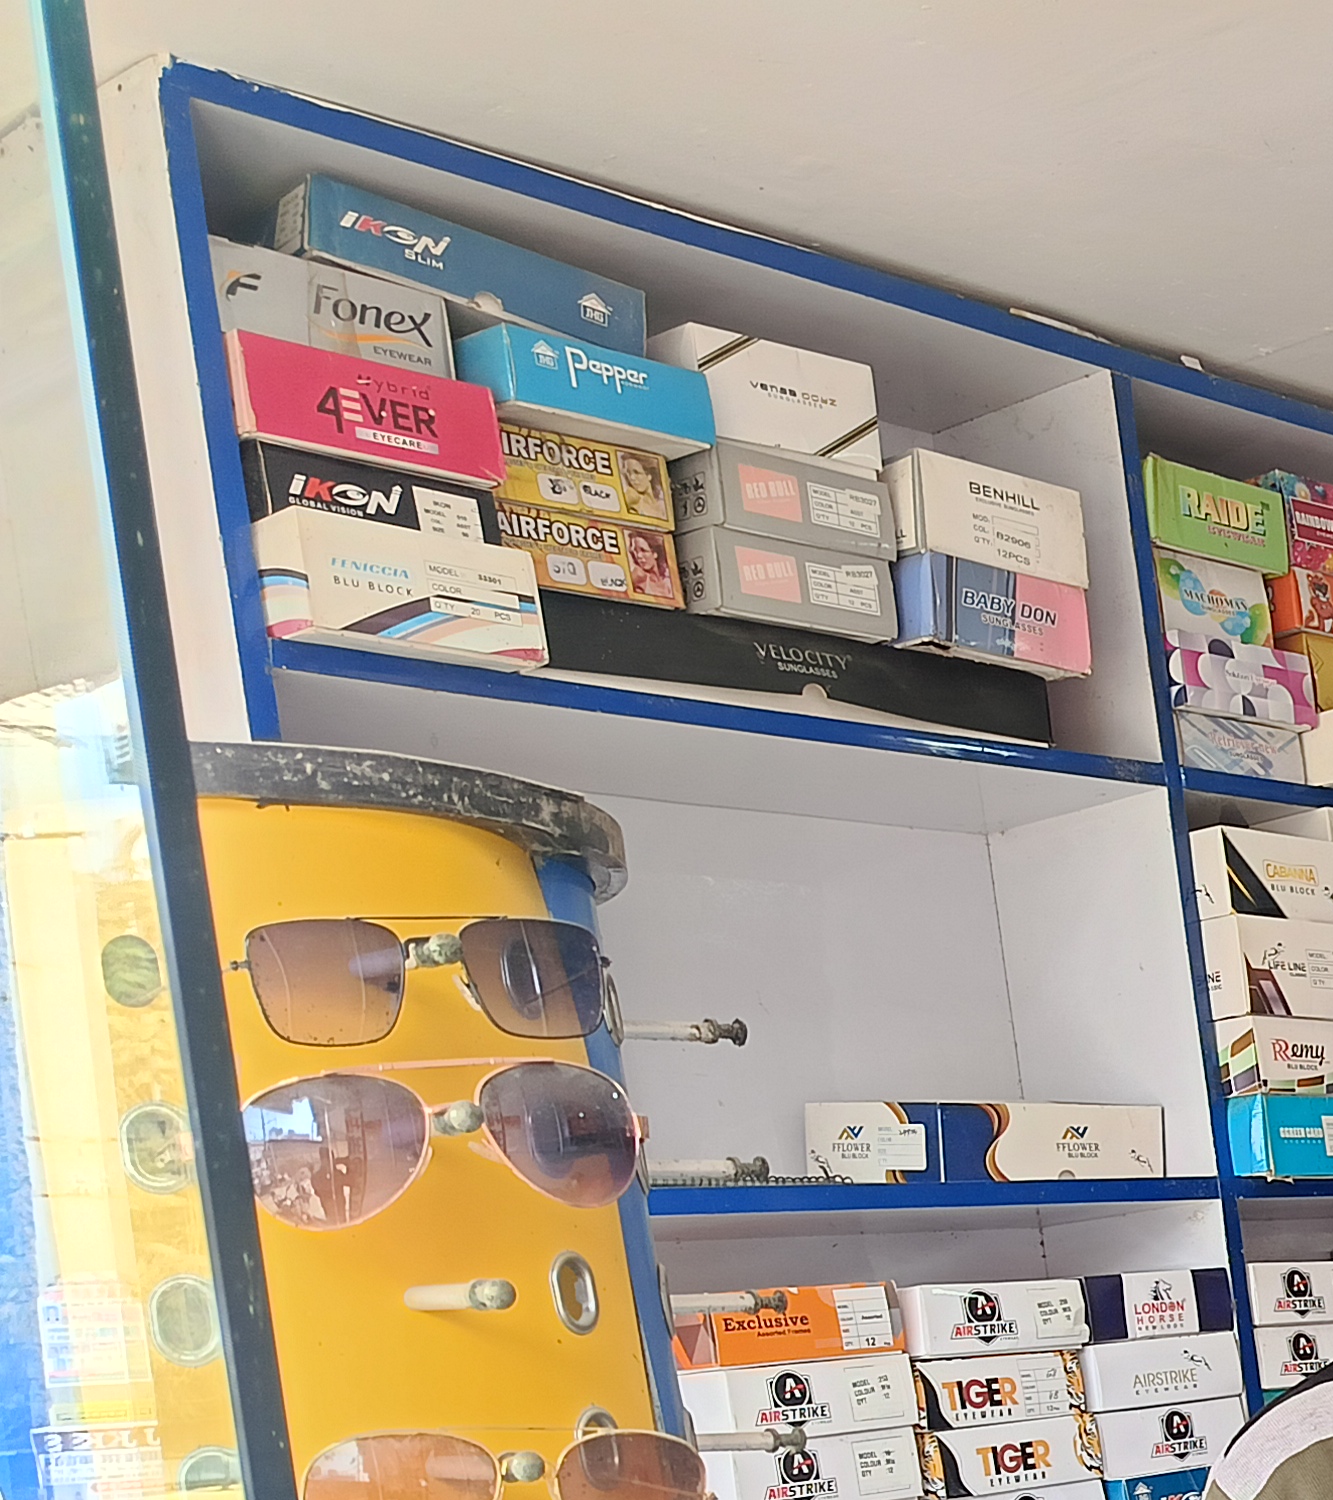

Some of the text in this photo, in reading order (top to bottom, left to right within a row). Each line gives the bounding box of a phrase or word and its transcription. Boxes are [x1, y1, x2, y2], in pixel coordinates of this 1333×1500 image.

[404, 248, 445, 270] SLIM
[312, 283, 433, 348] Fonex
[373, 346, 432, 367] EYEWEAR
[564, 346, 648, 393] Pepper
[316, 386, 438, 439] 4EVER
[372, 432, 423, 450] EYECARE
[500, 430, 612, 475] IRFORCE
[745, 479, 796, 500] RED BULL
[812, 487, 832, 499] MODEL
[968, 480, 1041, 512] BENHILL
[289, 496, 364, 517] GLOBAL VISION
[497, 511, 620, 555] AIRFORCE
[330, 557, 410, 580] FENICCIA
[428, 564, 459, 579] MODEL
[743, 560, 796, 581] RED BULL
[811, 567, 831, 579] MODEL
[333, 575, 414, 597] BLU BLOCK
[431, 584, 463, 596] COLOR
[470, 607, 512, 622] 20 PCS
[961, 588, 1058, 627] BABY DON
[980, 613, 1045, 636] SUNGLASSES
[753, 641, 848, 669] VELOCITY
[777, 662, 838, 679] SUNGLASSES
[1266, 863, 1316, 884] CABANNA
[1290, 886, 1315, 895] BLOCK
[1268, 961, 1306, 972] LIFE LINE
[832, 1143, 871, 1152] FFLOWER
[1056, 1143, 1100, 1151] FFLOWER
[1133, 1300, 1185, 1316] LONDON
[1277, 1299, 1324, 1309] AIRSTRIKE
[723, 1312, 810, 1333] Exclusive
[1136, 1312, 1185, 1325] HORSE
[953, 1321, 1016, 1337] AIRSTRIKE
[1132, 1369, 1198, 1389] AIRSTRIKE
[1135, 1383, 1198, 1395] EYEWEAR
[942, 1377, 1019, 1409] TIGER
[758, 1404, 829, 1424] AIRSTRIKE
[955, 1409, 1013, 1421] EYEWEAR
[976, 1439, 1052, 1474] TIGER
[1153, 1437, 1207, 1456] AIRSTRIKE
[989, 1471, 1046, 1487] EYEWEAR
[767, 1480, 836, 1500] AIRSTRIKE
